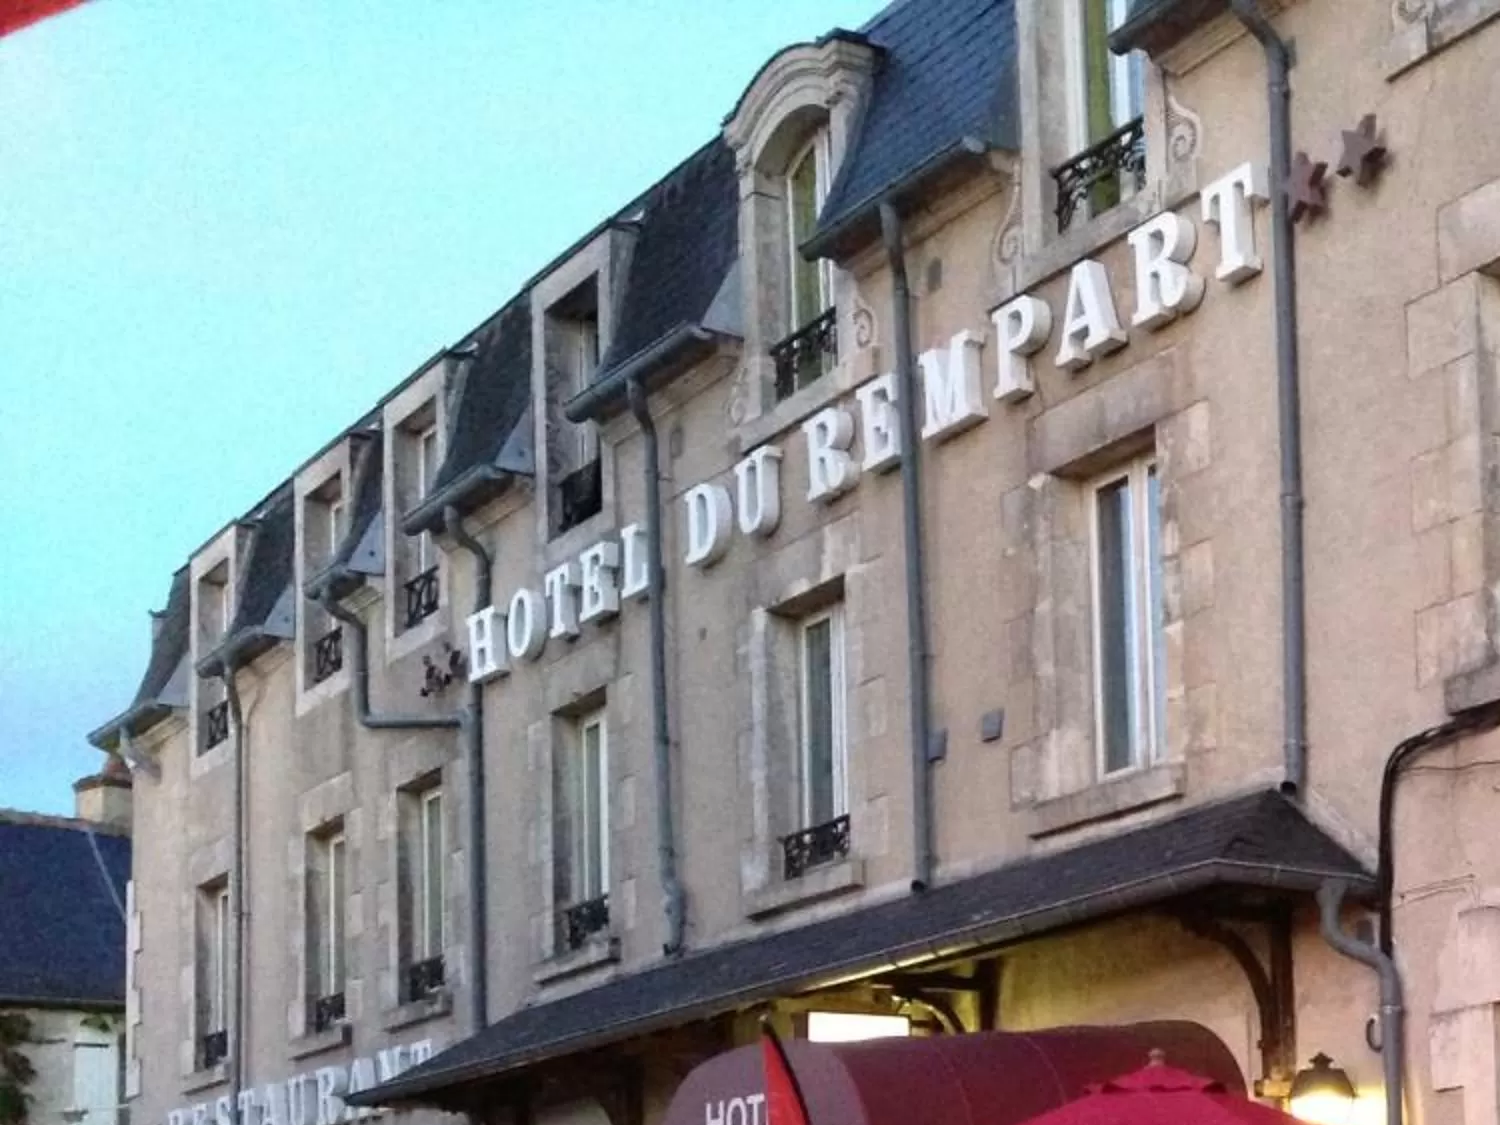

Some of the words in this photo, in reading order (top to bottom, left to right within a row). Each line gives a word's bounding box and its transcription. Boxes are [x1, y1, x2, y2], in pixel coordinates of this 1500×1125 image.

[467, 523, 650, 683] HOTEL
[684, 445, 783, 567] DU
[801, 161, 1269, 502] REMPART
